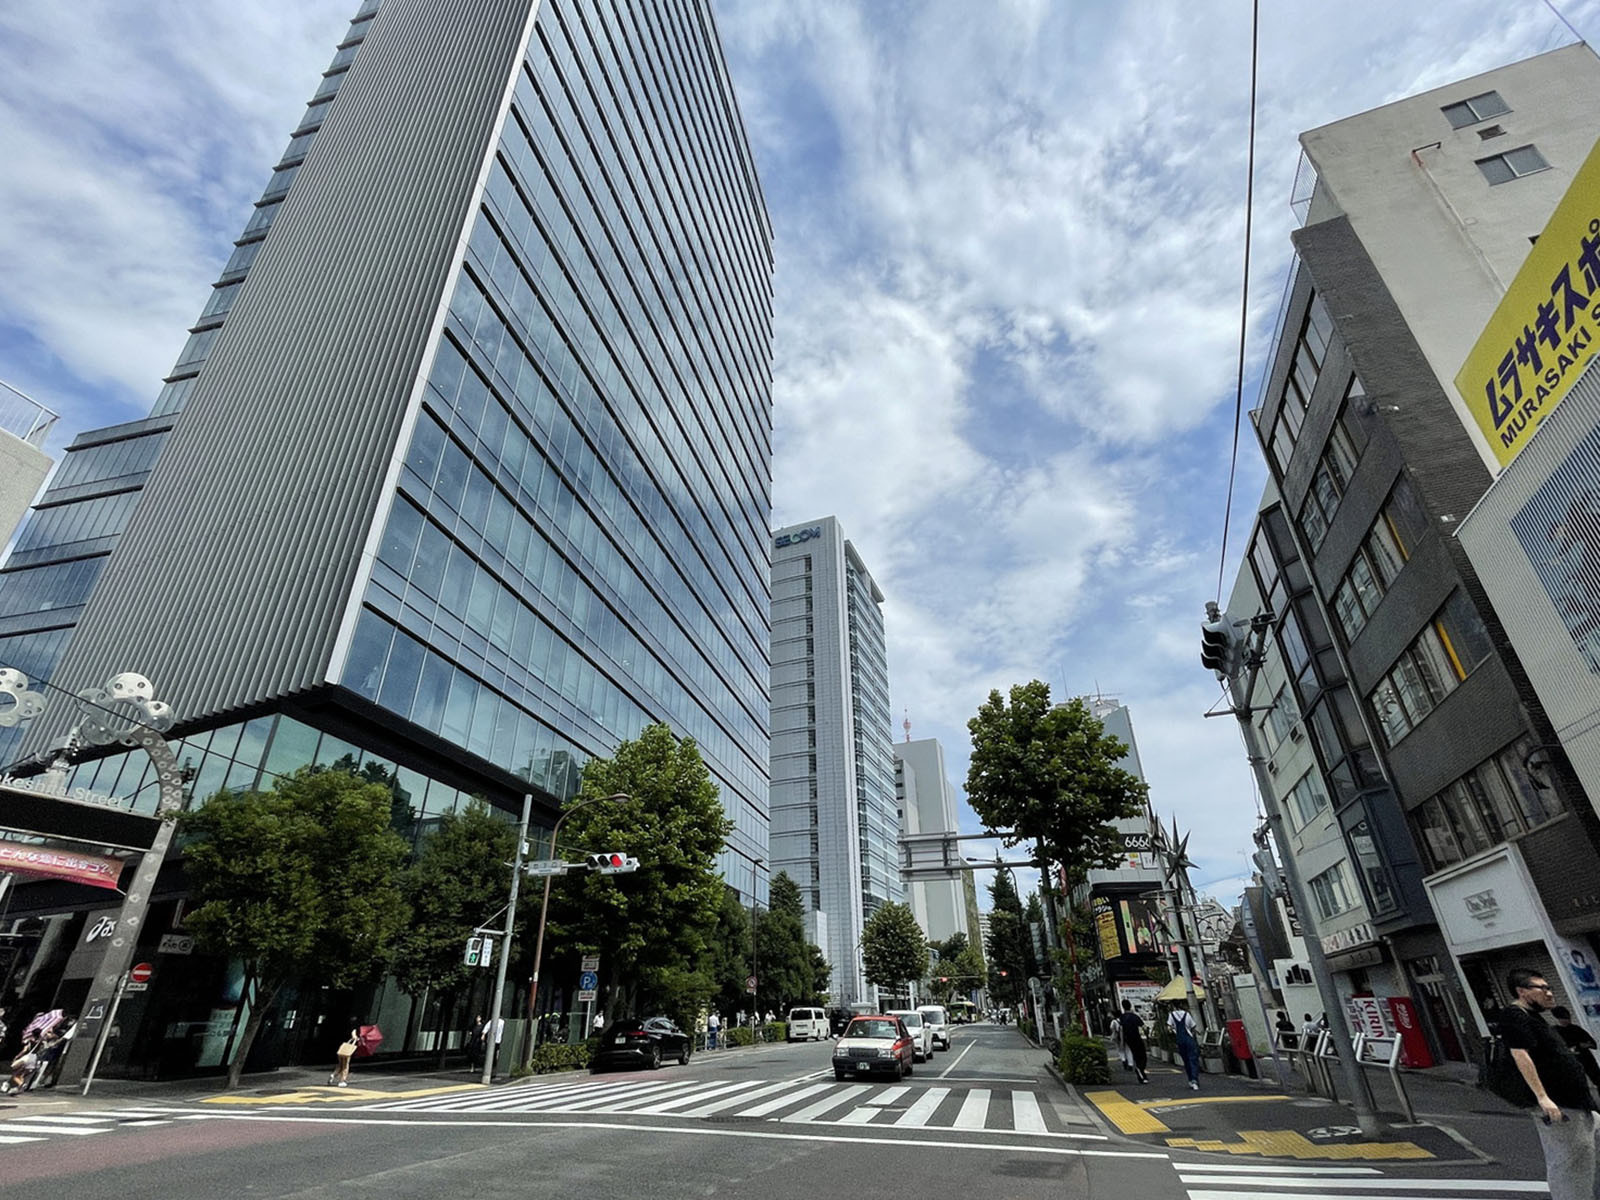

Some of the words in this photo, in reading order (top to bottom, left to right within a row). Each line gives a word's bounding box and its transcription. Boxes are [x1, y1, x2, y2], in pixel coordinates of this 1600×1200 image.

[1500, 325, 1592, 449] MURASAKI
[775, 526, 821, 548] SECOM
[0, 773, 67, 797] keshita
[75, 787, 123, 807] Street
